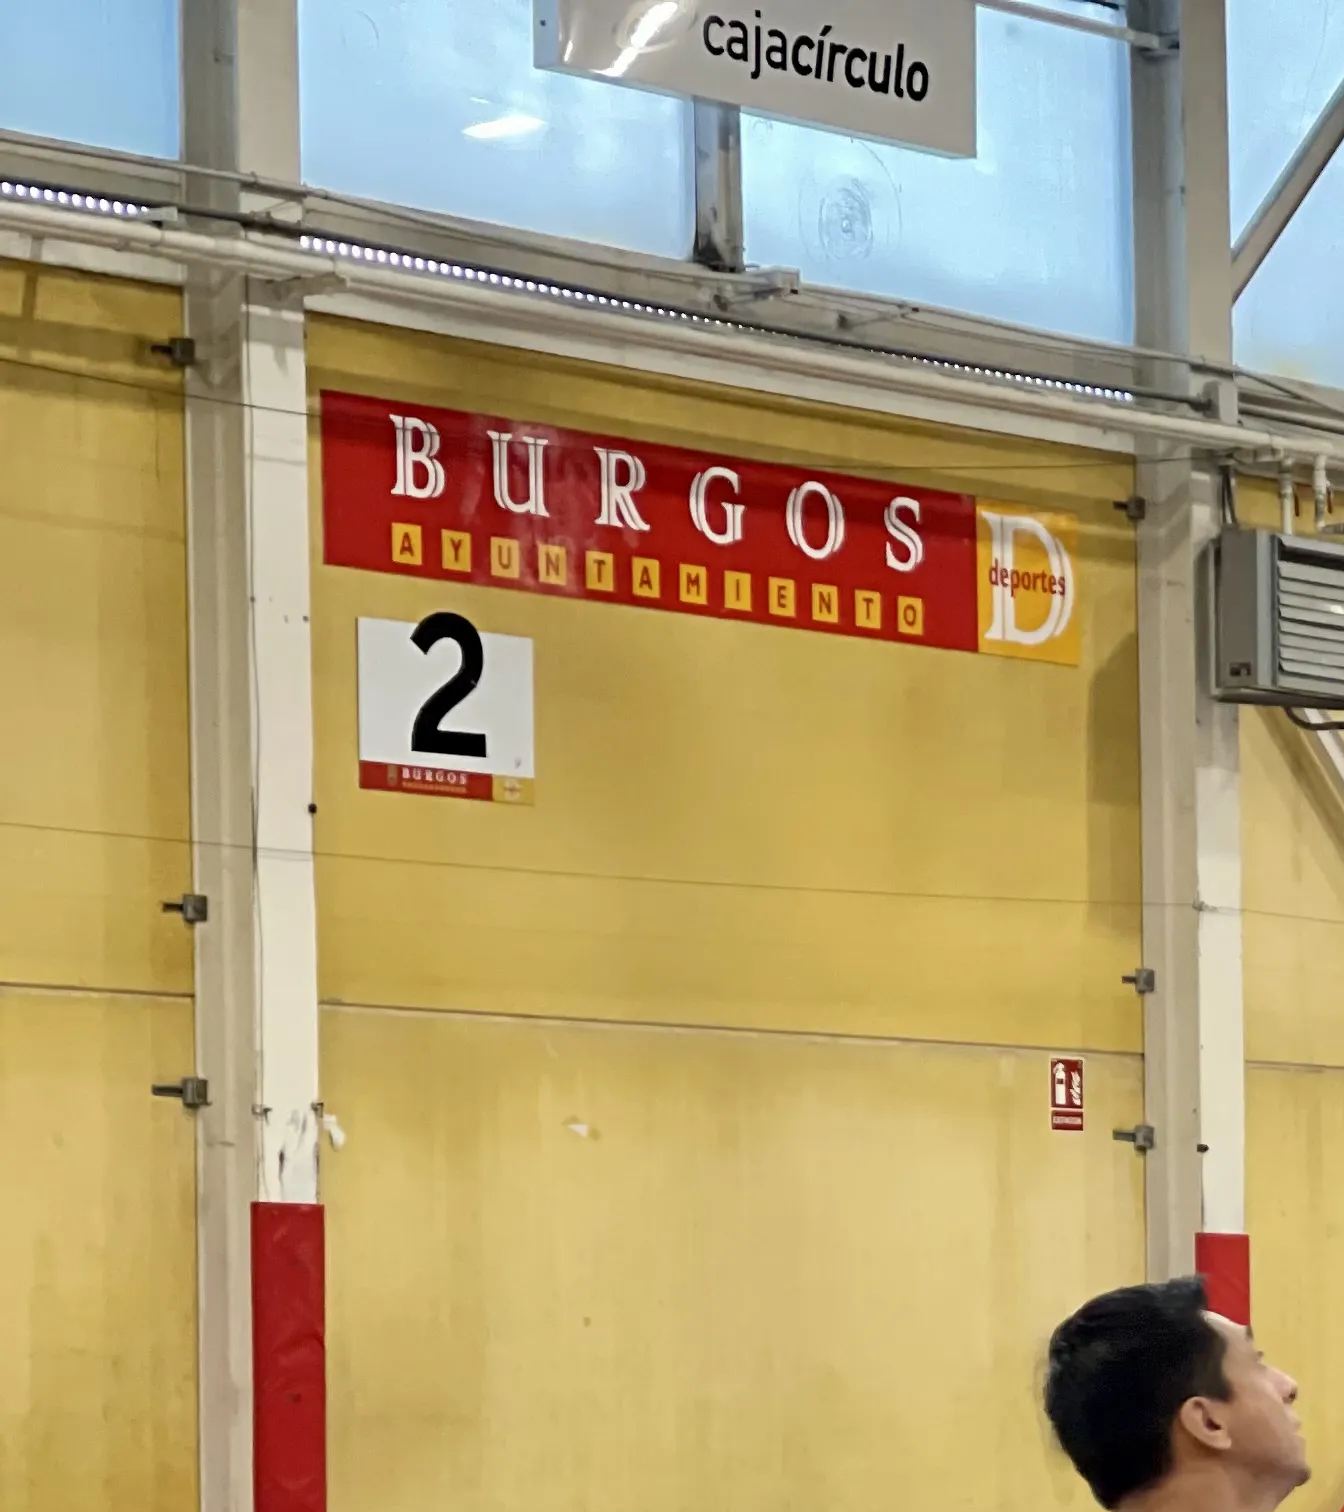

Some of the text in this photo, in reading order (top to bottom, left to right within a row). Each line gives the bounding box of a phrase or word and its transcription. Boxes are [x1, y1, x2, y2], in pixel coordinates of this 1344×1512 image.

[702, 9, 930, 102] cajacírculo
[388, 412, 925, 573] BURGOS
[396, 528, 920, 632] AYUNTAMIENTO
[987, 556, 1067, 600] deportes
[409, 611, 487, 758] 2
